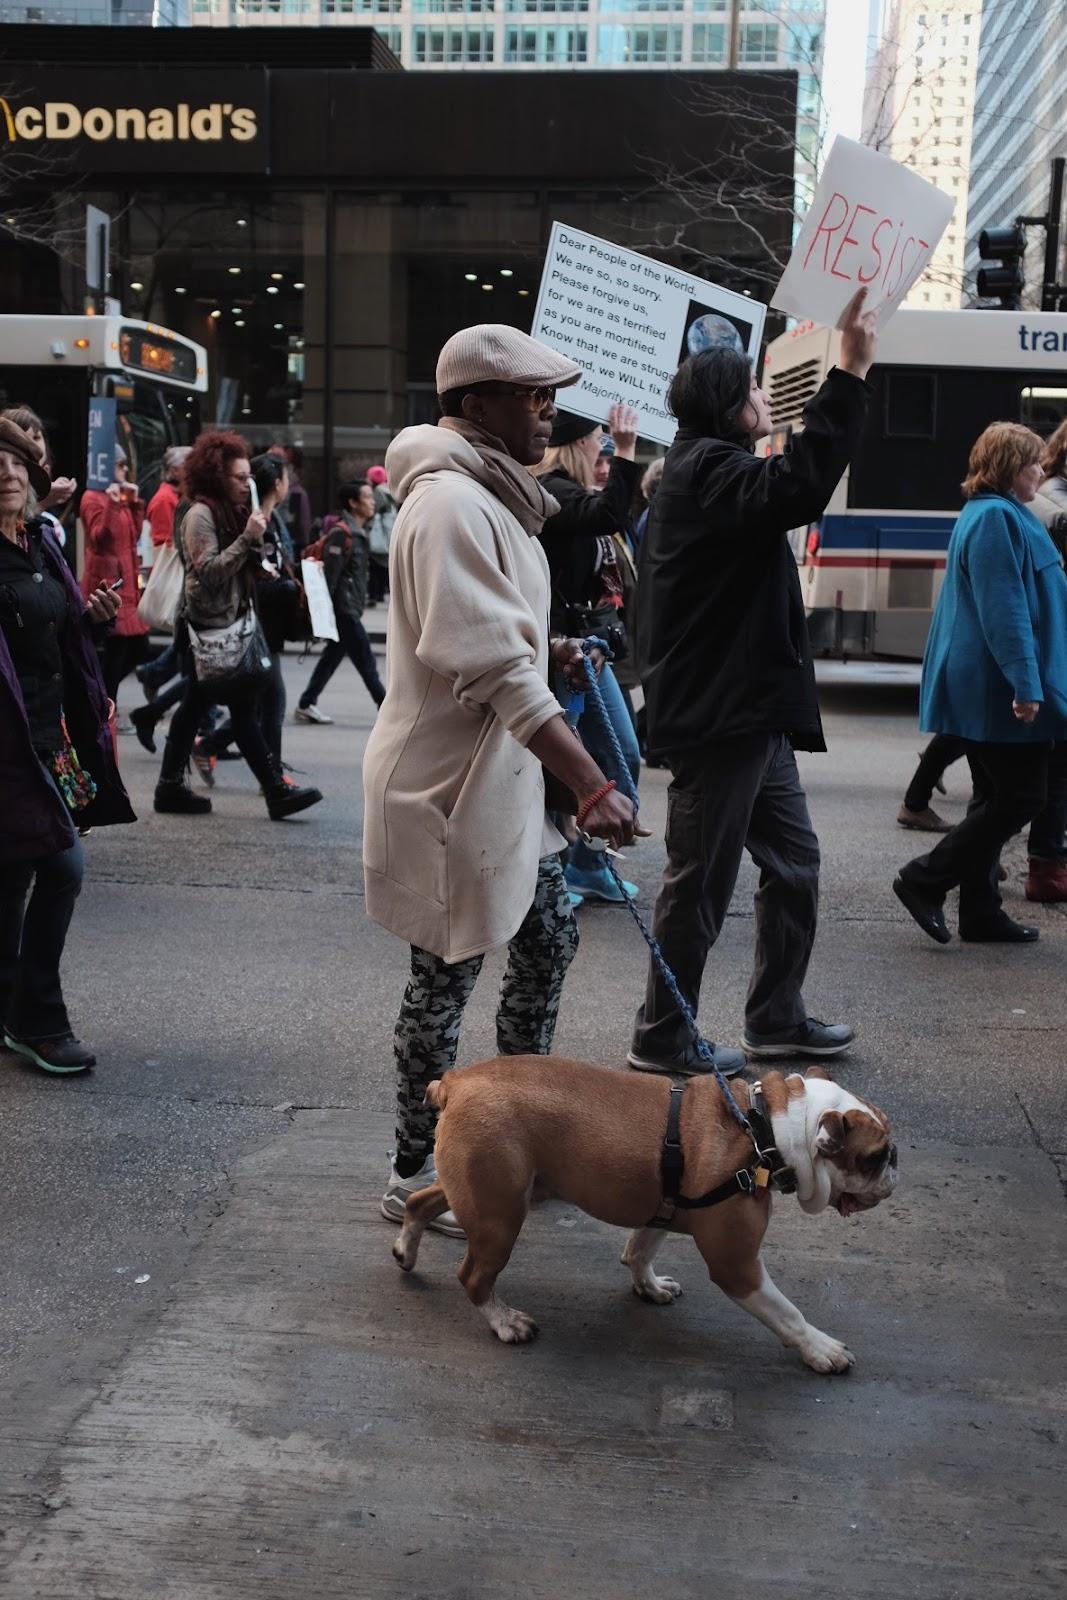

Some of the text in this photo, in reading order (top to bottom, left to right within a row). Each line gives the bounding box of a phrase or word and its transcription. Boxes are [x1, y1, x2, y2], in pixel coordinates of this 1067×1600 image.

[556, 252, 662, 302] We are so, so sorry.
[559, 233, 697, 296] Dear People of the World,
[548, 288, 666, 340] for we are as terrified
[552, 270, 648, 316] Please forgive us,
[541, 324, 573, 343] Know
[577, 339, 598, 353] that
[602, 348, 617, 360] we
[620, 355, 638, 368] are
[544, 309, 656, 356] as you are mortified.
[581, 380, 626, 404] Majority
[628, 399, 640, 409] of
[600, 367, 615, 378] we
[619, 372, 645, 390] WILL
[649, 384, 662, 396] fix
